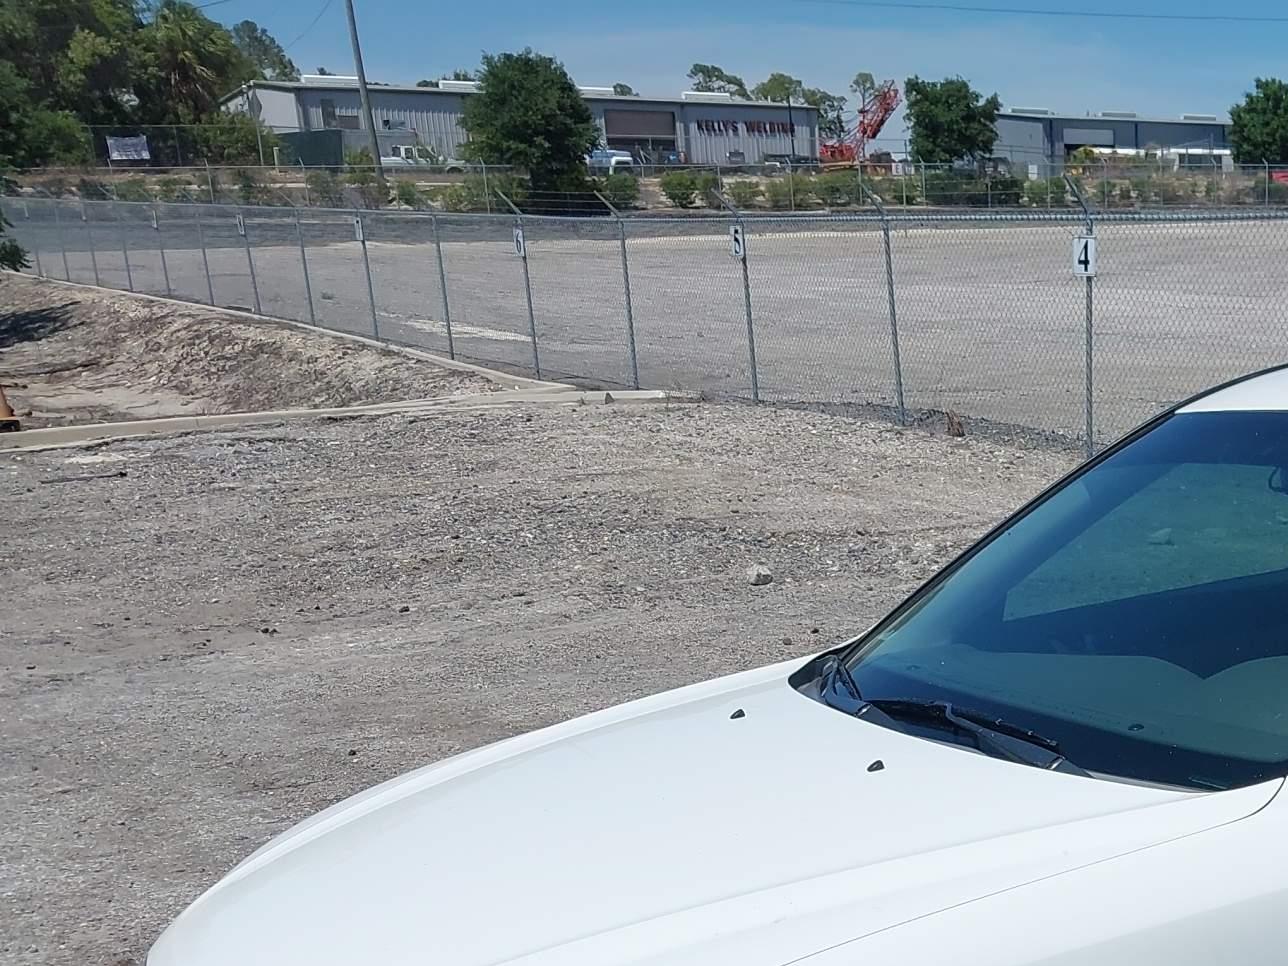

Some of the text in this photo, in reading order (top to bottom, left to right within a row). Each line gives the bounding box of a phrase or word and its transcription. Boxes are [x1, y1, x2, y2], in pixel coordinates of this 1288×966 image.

[515, 231, 522, 253] 6
[733, 229, 741, 254] 5
[1078, 239, 1090, 272] 4
